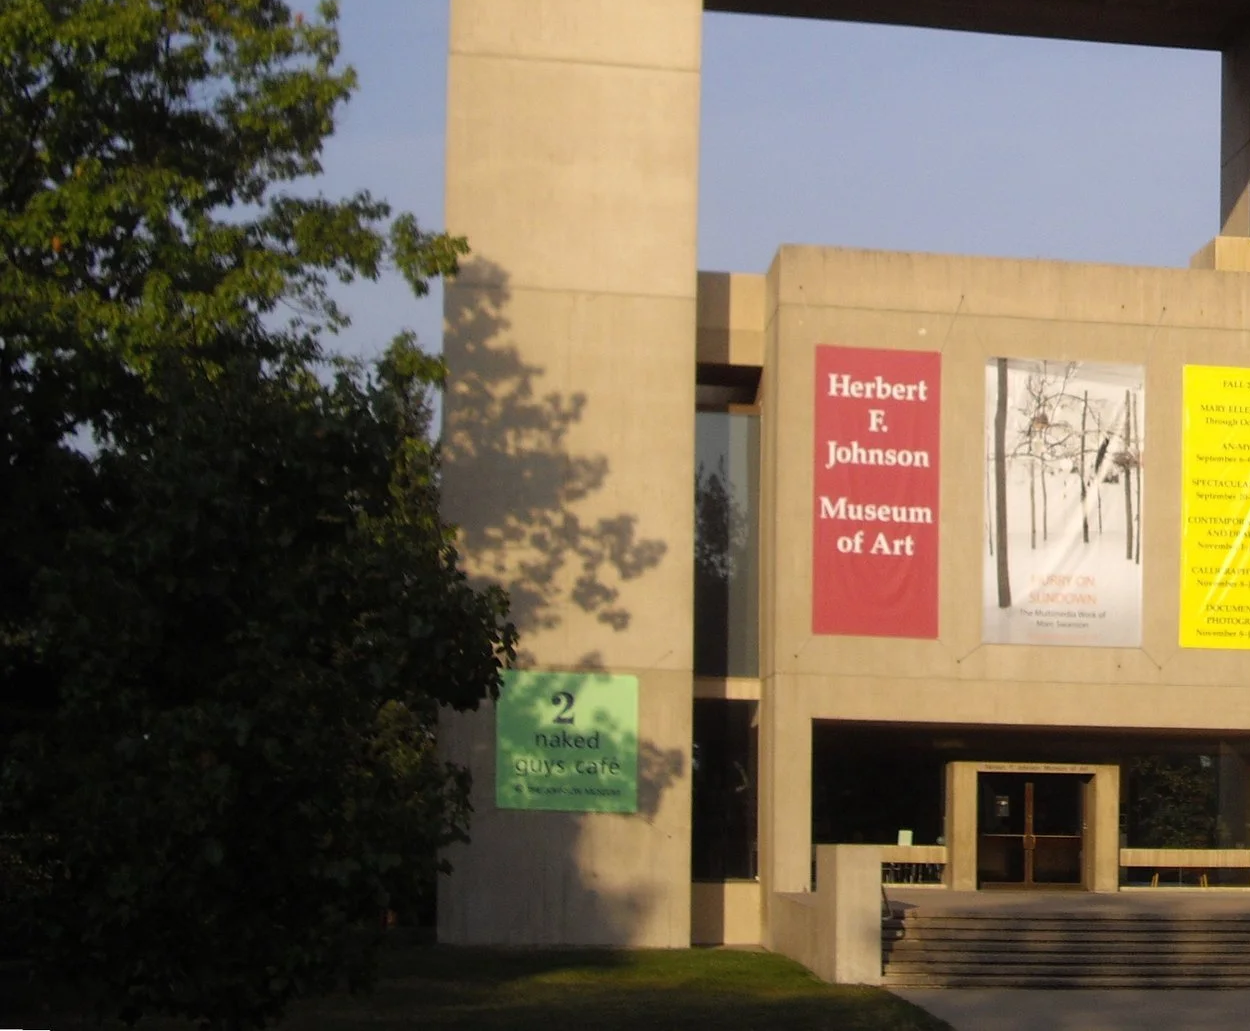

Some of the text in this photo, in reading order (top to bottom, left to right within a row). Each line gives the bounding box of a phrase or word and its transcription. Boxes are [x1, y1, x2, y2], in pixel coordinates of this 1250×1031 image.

[828, 373, 928, 401] Herbert
[1223, 379, 1244, 388] FALL
[1200, 403, 1226, 413] MARY
[868, 409, 888, 432] F.
[1205, 416, 1238, 427] Through
[1222, 442, 1250, 452] AN-MY
[825, 441, 931, 470] Johnson
[1196, 454, 1237, 464] September
[1196, 491, 1237, 502] September
[819, 496, 933, 524] Museum
[1206, 528, 1227, 537] AND
[837, 532, 915, 556] of Art
[1196, 628, 1237, 638] November
[551, 691, 575, 725] 2
[535, 730, 600, 750] naked
[515, 755, 620, 776] guys café
